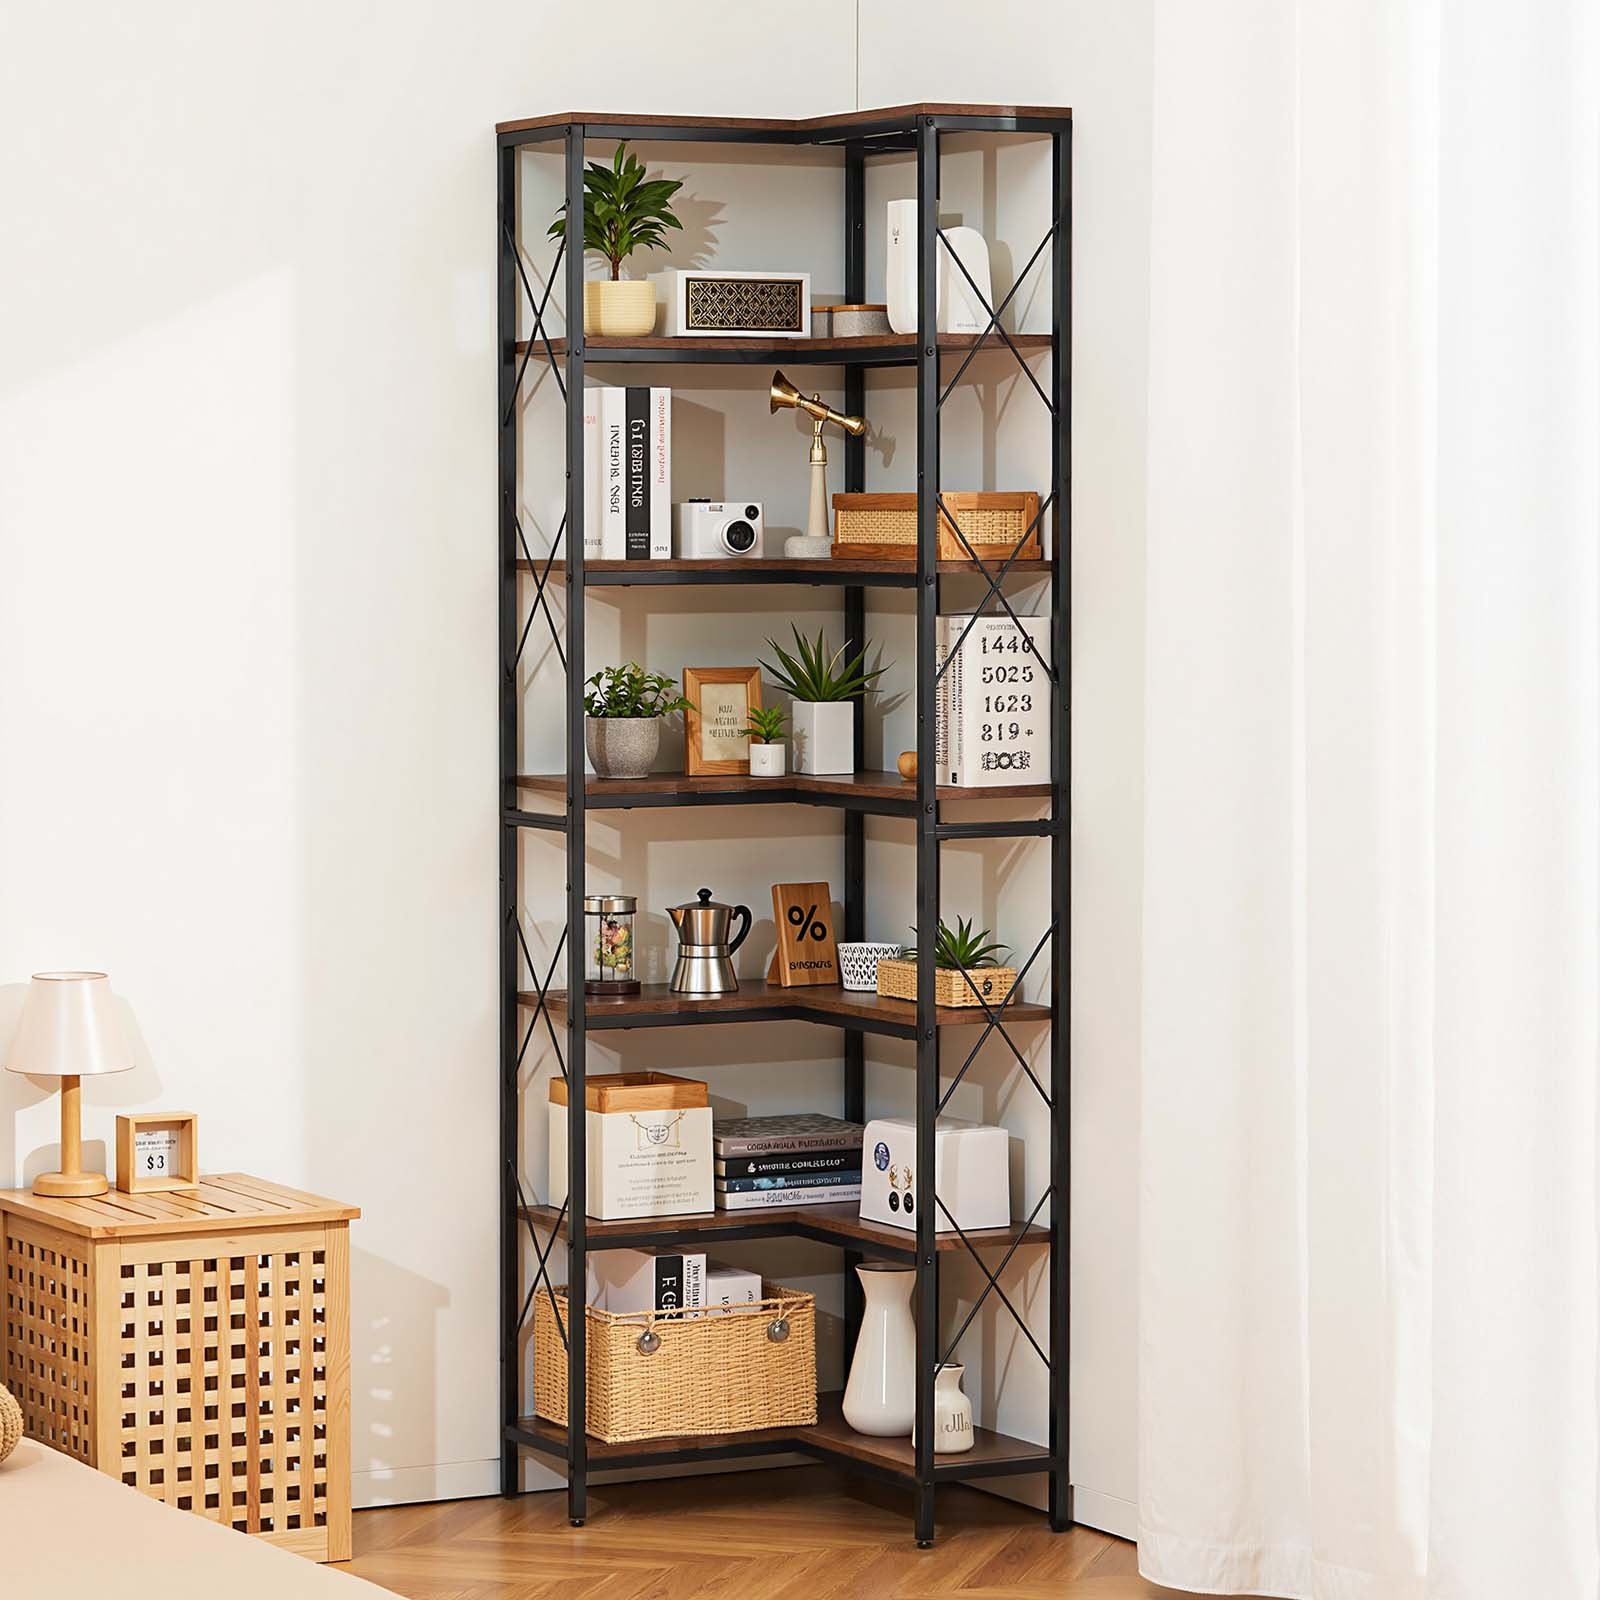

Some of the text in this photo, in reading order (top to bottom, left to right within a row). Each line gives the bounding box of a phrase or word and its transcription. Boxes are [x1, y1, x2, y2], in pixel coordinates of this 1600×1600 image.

[982, 665, 1034, 684] 5025
[985, 694, 1032, 713] 1623
[788, 905, 827, 942] %
